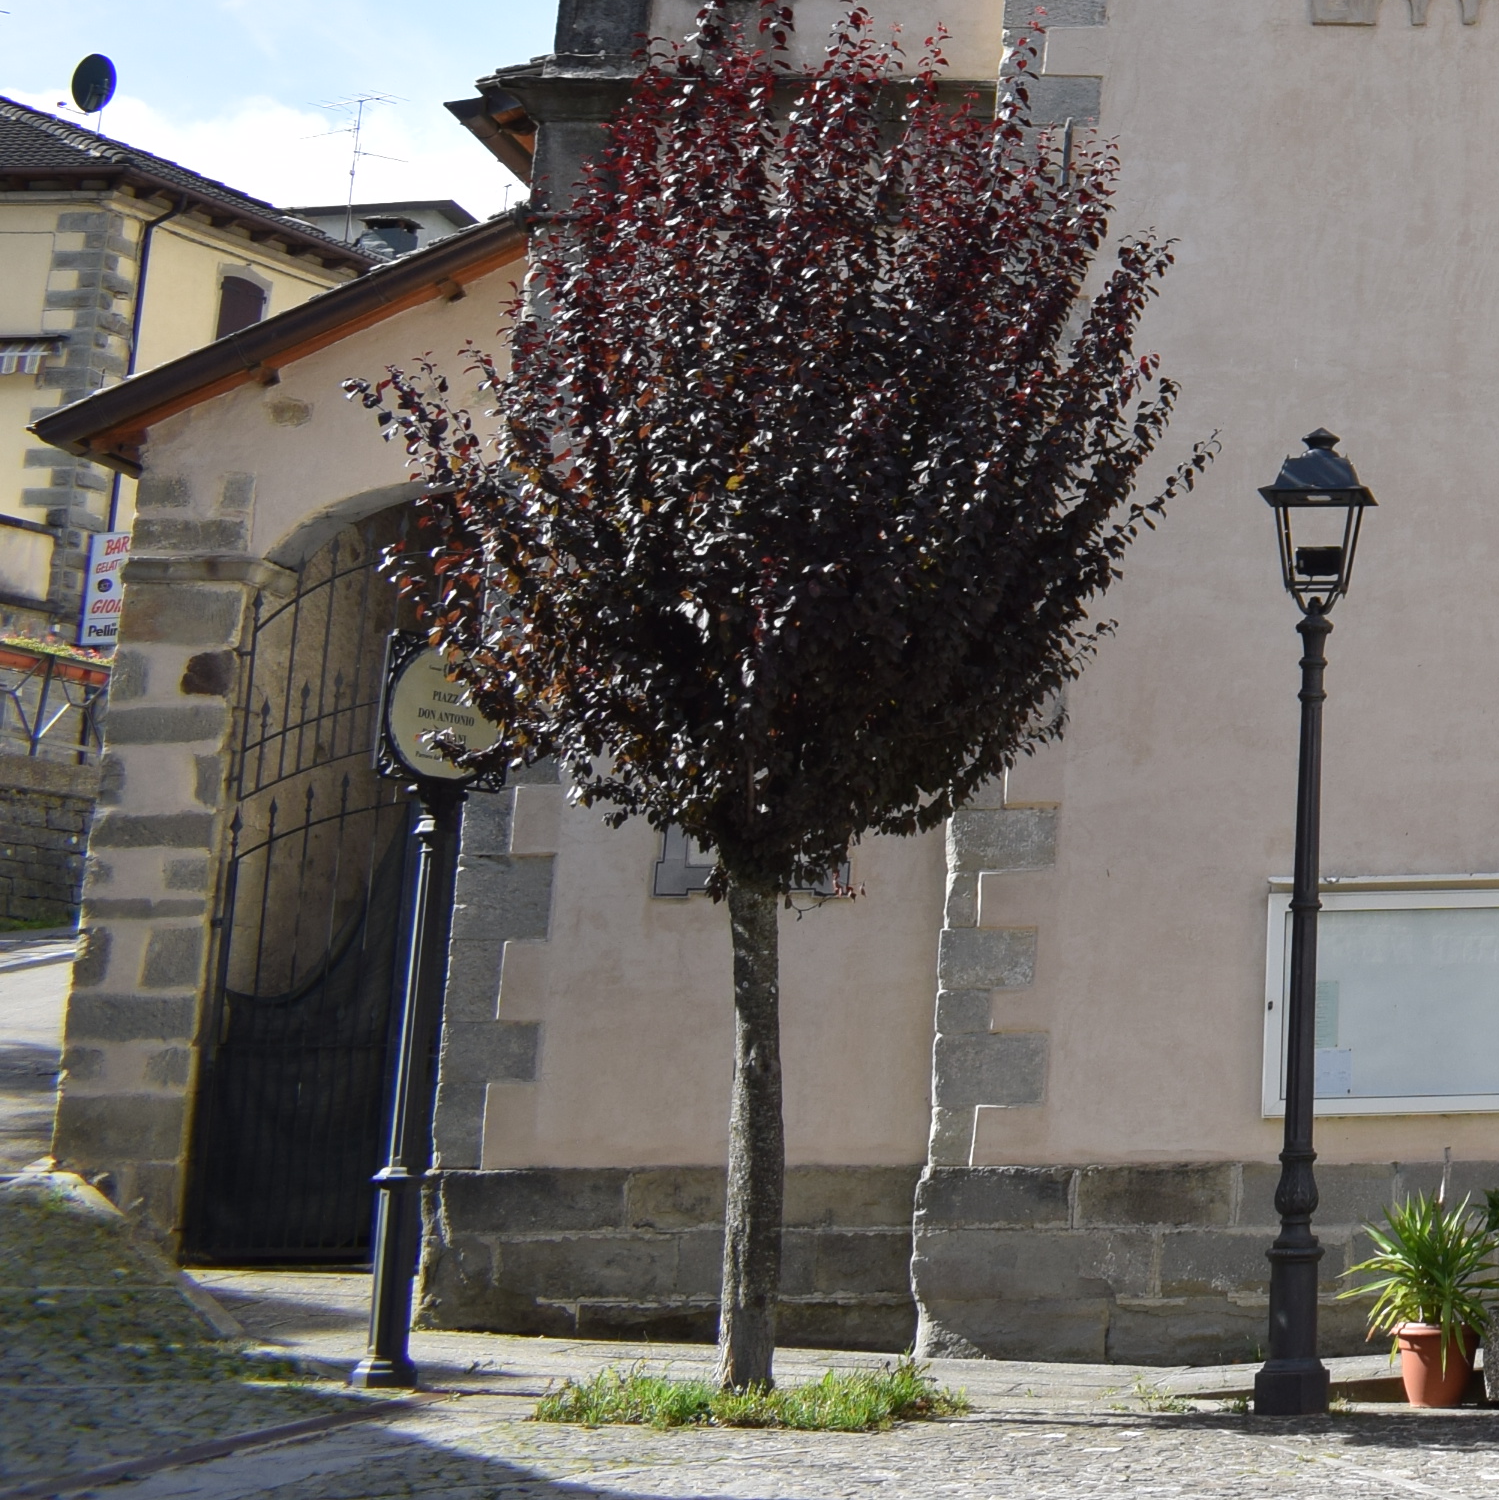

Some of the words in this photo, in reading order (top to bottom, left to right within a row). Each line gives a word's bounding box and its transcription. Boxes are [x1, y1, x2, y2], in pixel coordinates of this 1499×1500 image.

[105, 535, 130, 556] BAR
[96, 559, 121, 574] GELAT
[432, 690, 463, 705] PIAZZ
[418, 707, 436, 720] DON
[438, 711, 475, 727] ANTONIO
